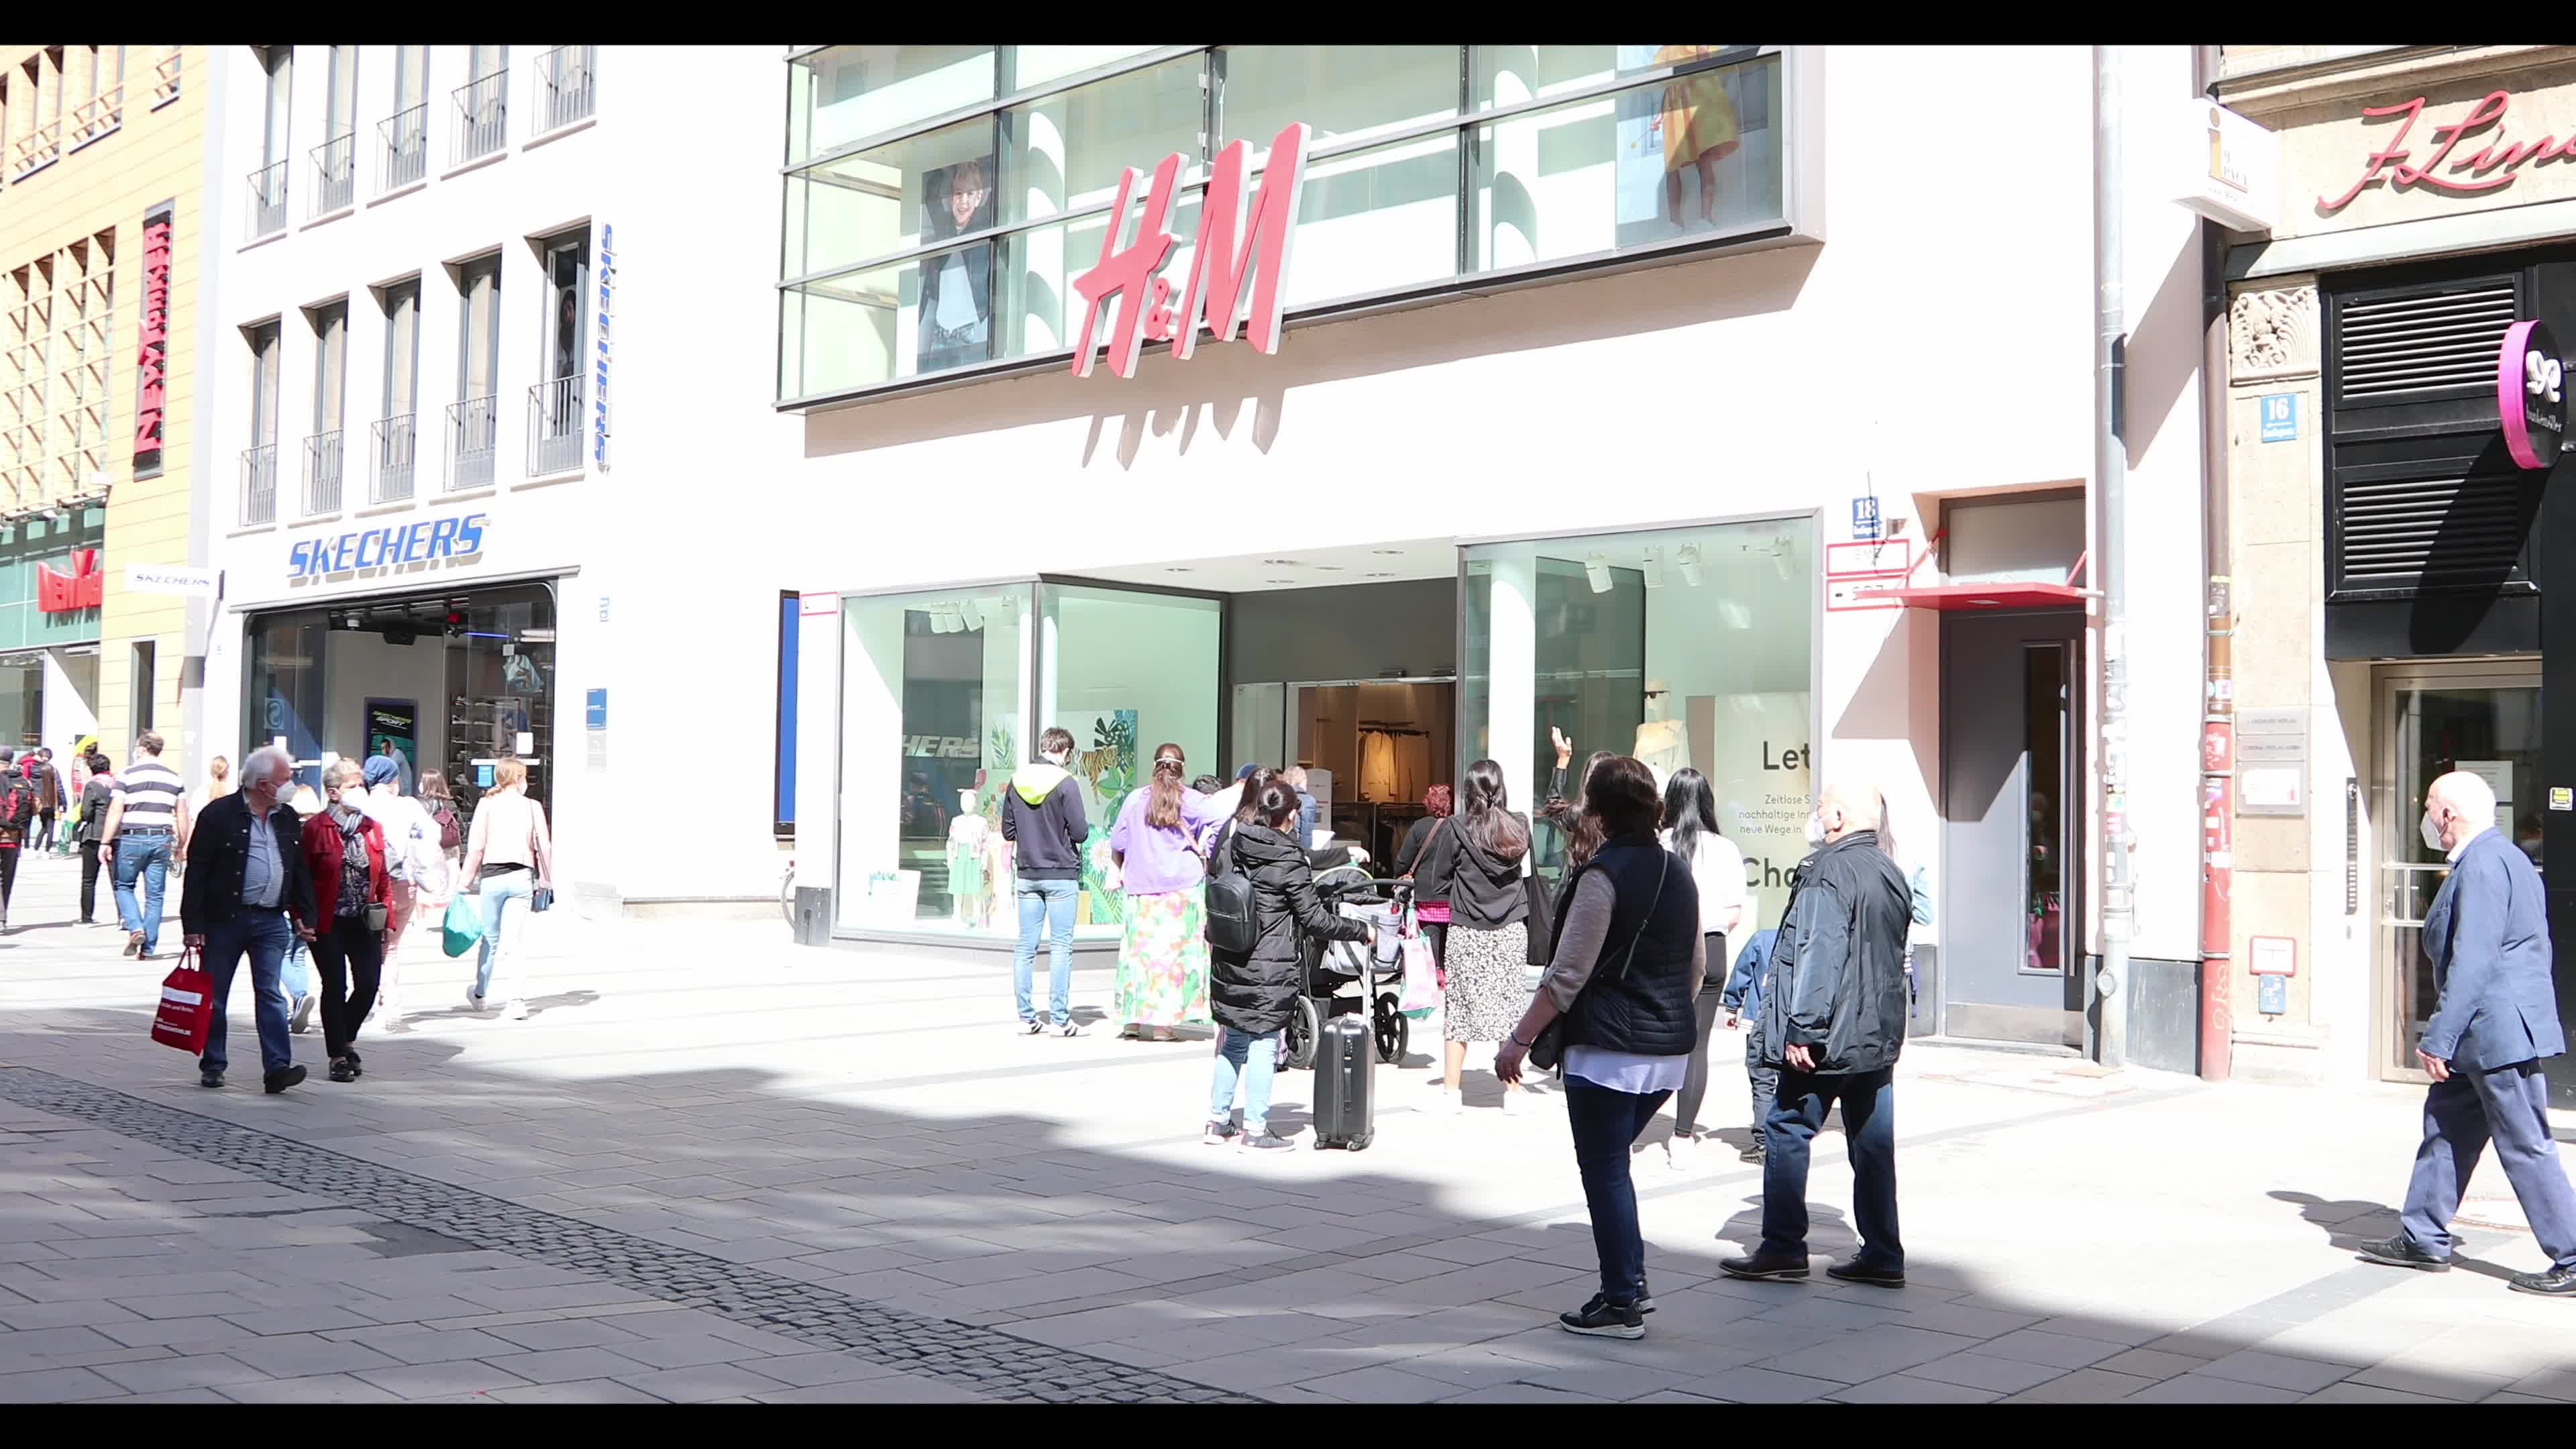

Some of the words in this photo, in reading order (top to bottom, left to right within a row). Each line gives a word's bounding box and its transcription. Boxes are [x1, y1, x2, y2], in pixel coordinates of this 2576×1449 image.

[1071, 121, 1312, 378] H&M
[594, 223, 613, 462] SKECHERS
[2267, 397, 2290, 420] 16
[1857, 499, 1876, 519] 18
[287, 513, 487, 578] SKECHERS
[136, 574, 210, 586] SKECHERS
[1763, 741, 1810, 770] Let
[1765, 794, 1802, 804] Zeitlose
[1739, 810, 1796, 822] nachhaltige
[1739, 826, 1763, 834] neue
[1765, 824, 1791, 836] Wege
[1793, 824, 1802, 834] in
